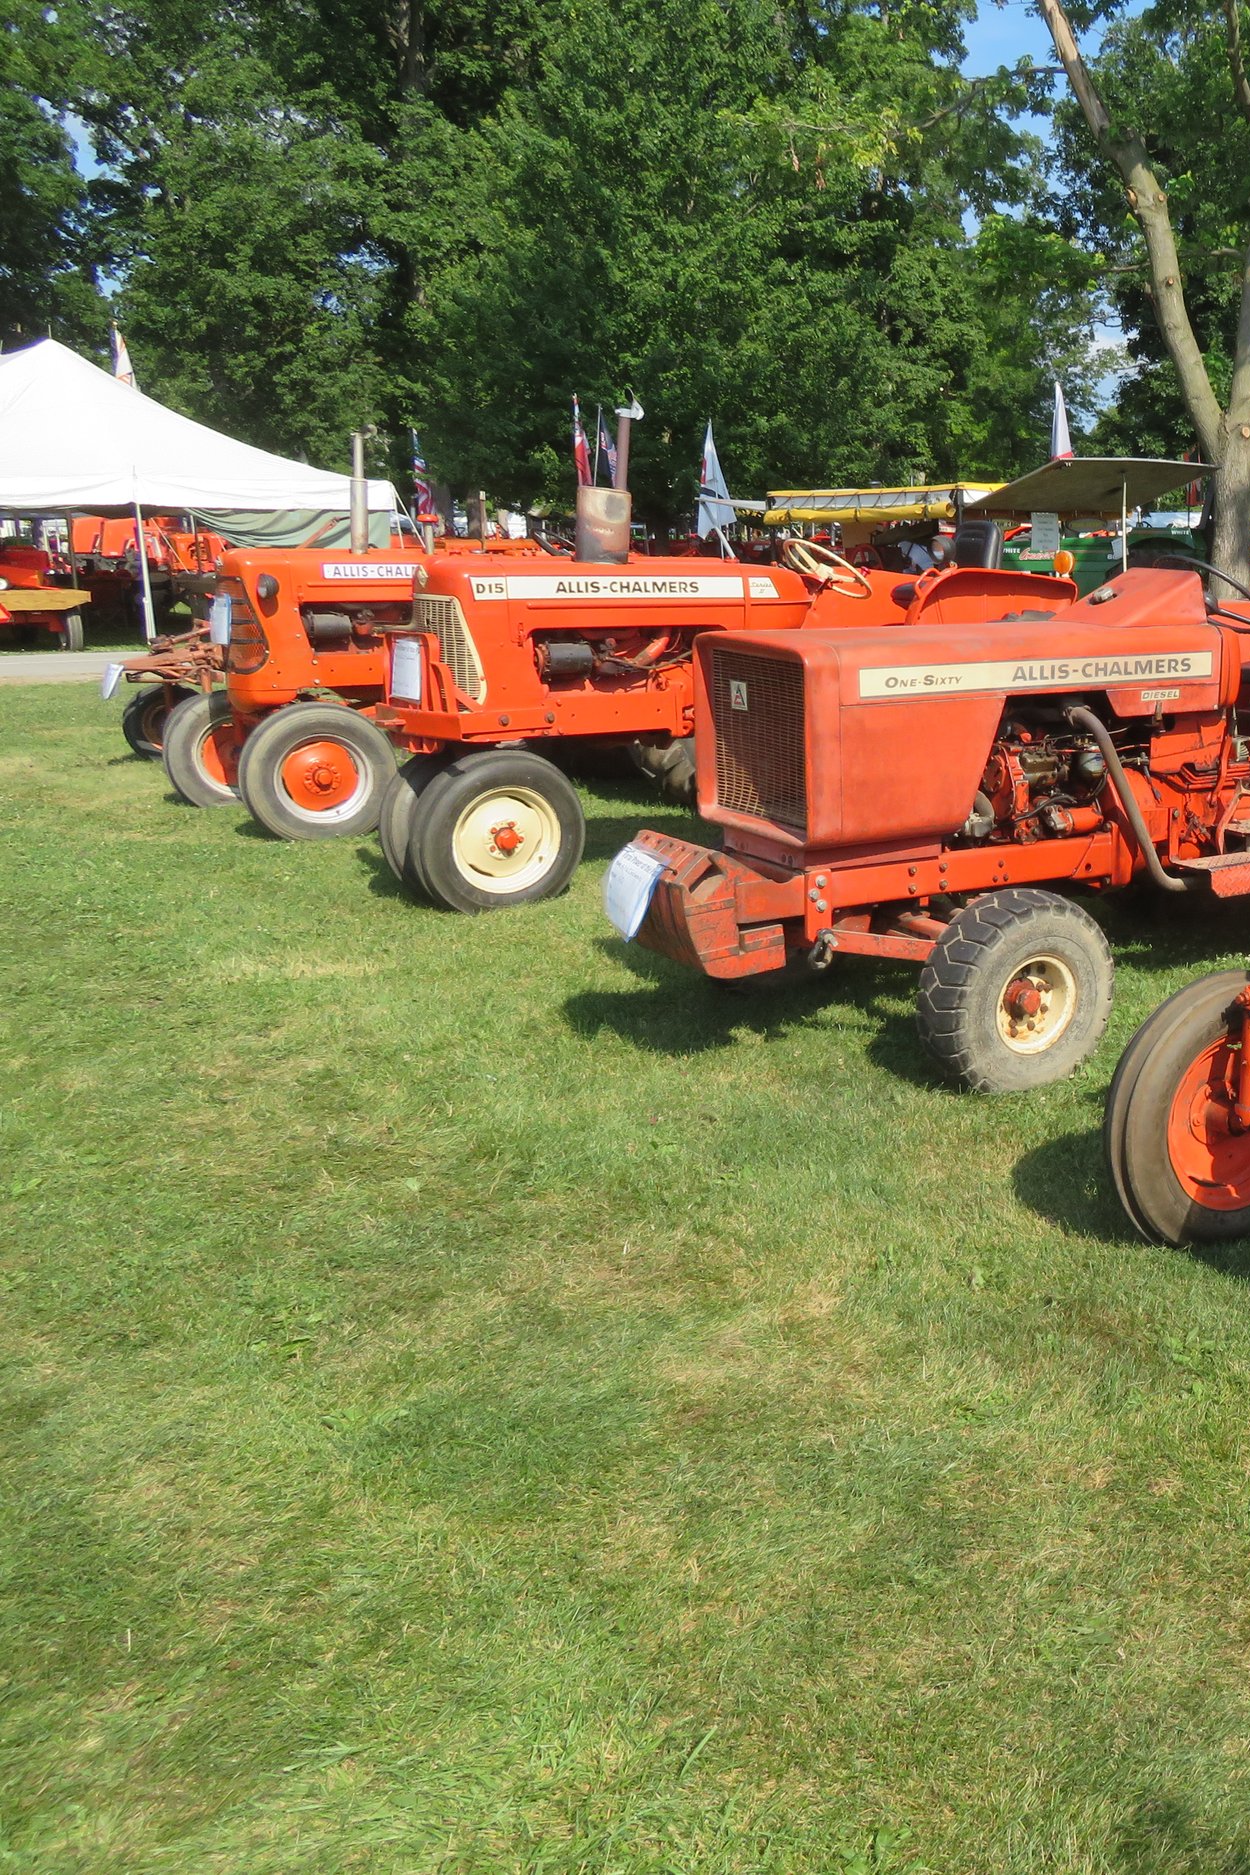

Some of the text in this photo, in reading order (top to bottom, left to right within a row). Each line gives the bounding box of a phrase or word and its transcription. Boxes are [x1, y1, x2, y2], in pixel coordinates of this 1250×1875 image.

[476, 583, 504, 594] D15
[555, 581, 699, 594] ALLIS-CHALMERS
[1012, 657, 1192, 682] ALLIS-CHALMERS
[1142, 690, 1180, 700] DIESEL
